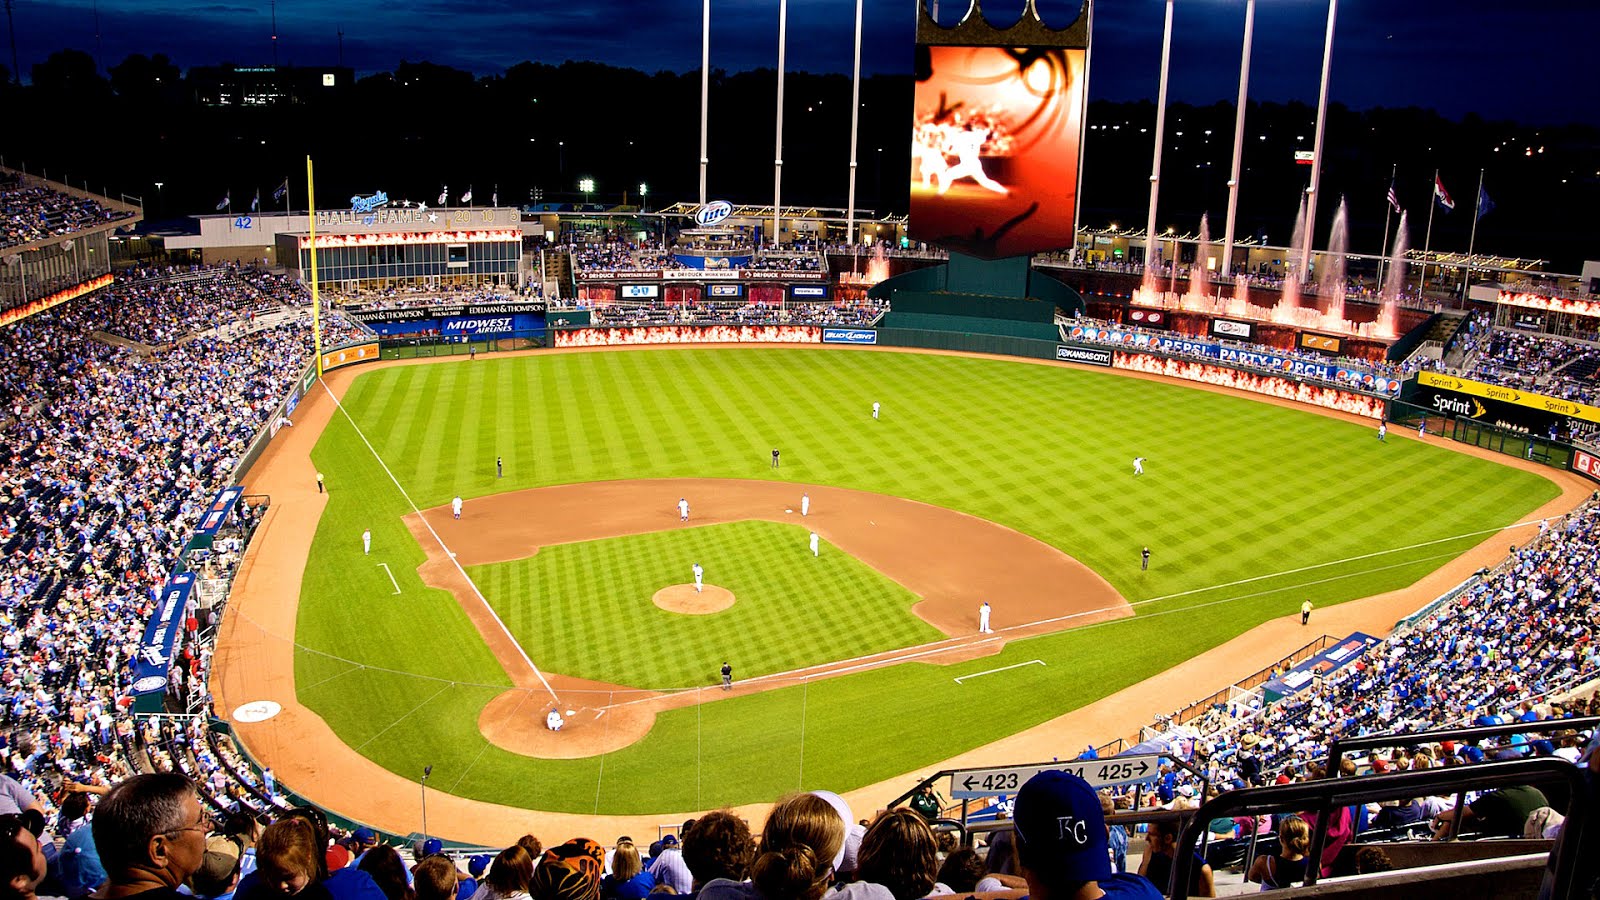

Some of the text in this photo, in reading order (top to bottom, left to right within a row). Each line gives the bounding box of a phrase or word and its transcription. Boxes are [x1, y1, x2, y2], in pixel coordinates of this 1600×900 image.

[350, 190, 388, 213] Royals
[317, 211, 361, 225] HALL
[378, 207, 423, 223] FAME
[454, 210, 470, 223] 20
[482, 209, 494, 222] 10
[703, 207, 728, 223] Lite
[235, 216, 252, 229] 42
[378, 311, 385, 320] &
[385, 310, 424, 319] THOMPSON
[469, 304, 544, 314] EDELMAN & THOMPSON
[447, 318, 512, 330] MIDWEST
[475, 325, 512, 334] AIRLINES
[846, 332, 874, 340] LIGHT
[1067, 350, 1094, 360] KANSAS
[1093, 353, 1109, 362] CITY
[1164, 340, 1206, 355] PEPSI
[1220, 349, 1268, 367] PARTY
[1430, 376, 1452, 388] Sprint
[1486, 388, 1509, 399] Sprint
[1433, 394, 1470, 415] Sprint
[1545, 400, 1569, 413] Sprint
[1566, 417, 1597, 434] Sprint
[982, 773, 1018, 790] 423
[1098, 763, 1132, 780] 425
[1056, 816, 1087, 844] KC
